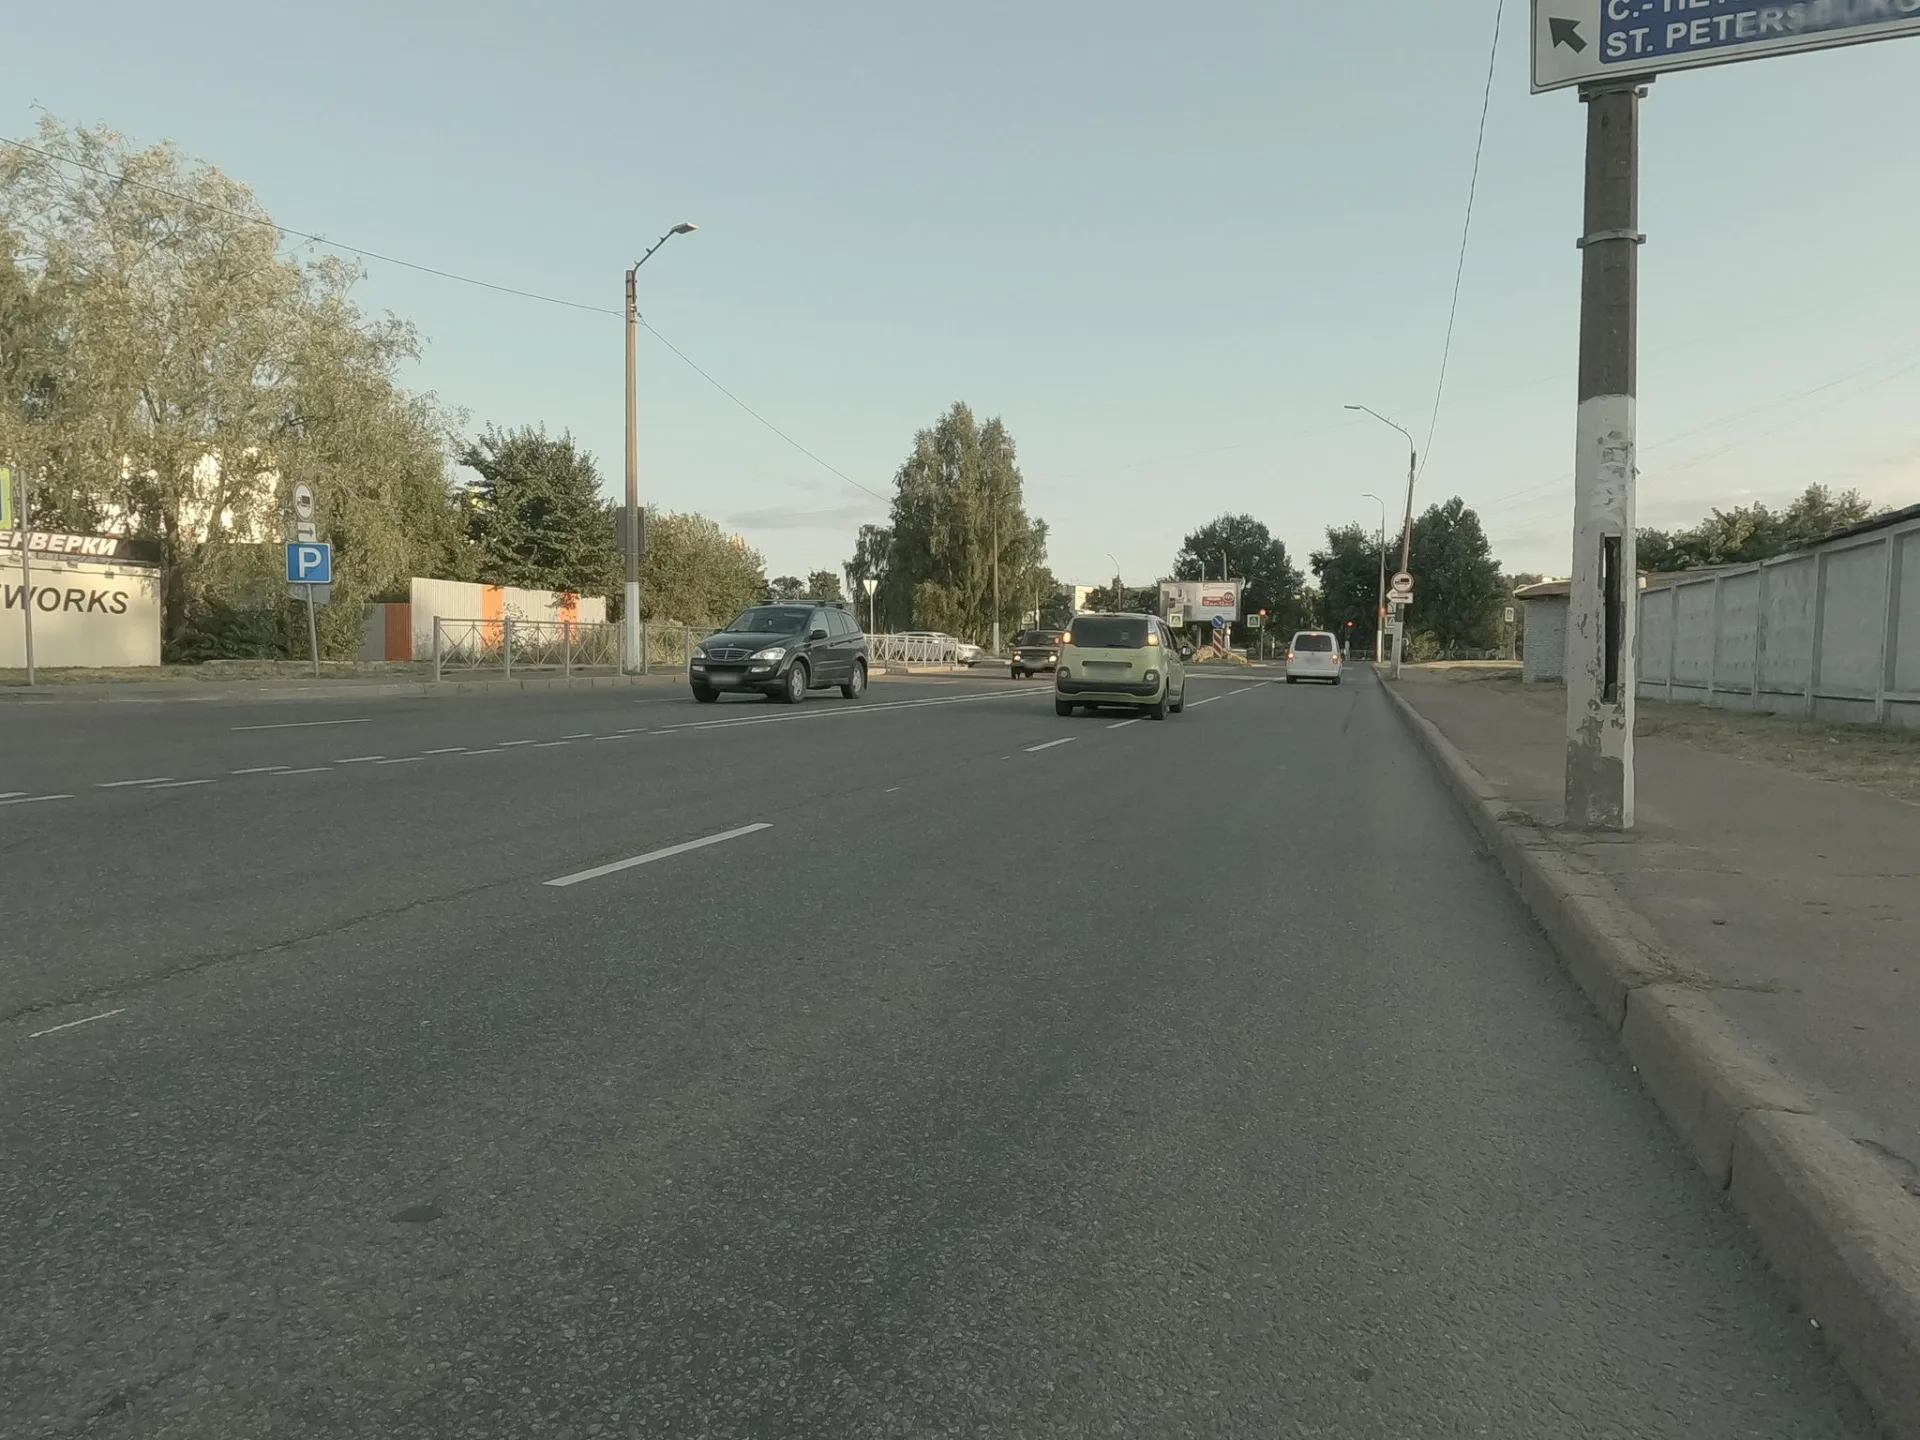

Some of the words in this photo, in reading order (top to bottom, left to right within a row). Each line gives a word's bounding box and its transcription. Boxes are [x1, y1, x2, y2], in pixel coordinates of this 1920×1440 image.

[1606, 27, 1654, 57] ST.
[298, 547, 322, 578] P
[0, 584, 129, 615] WORKS
